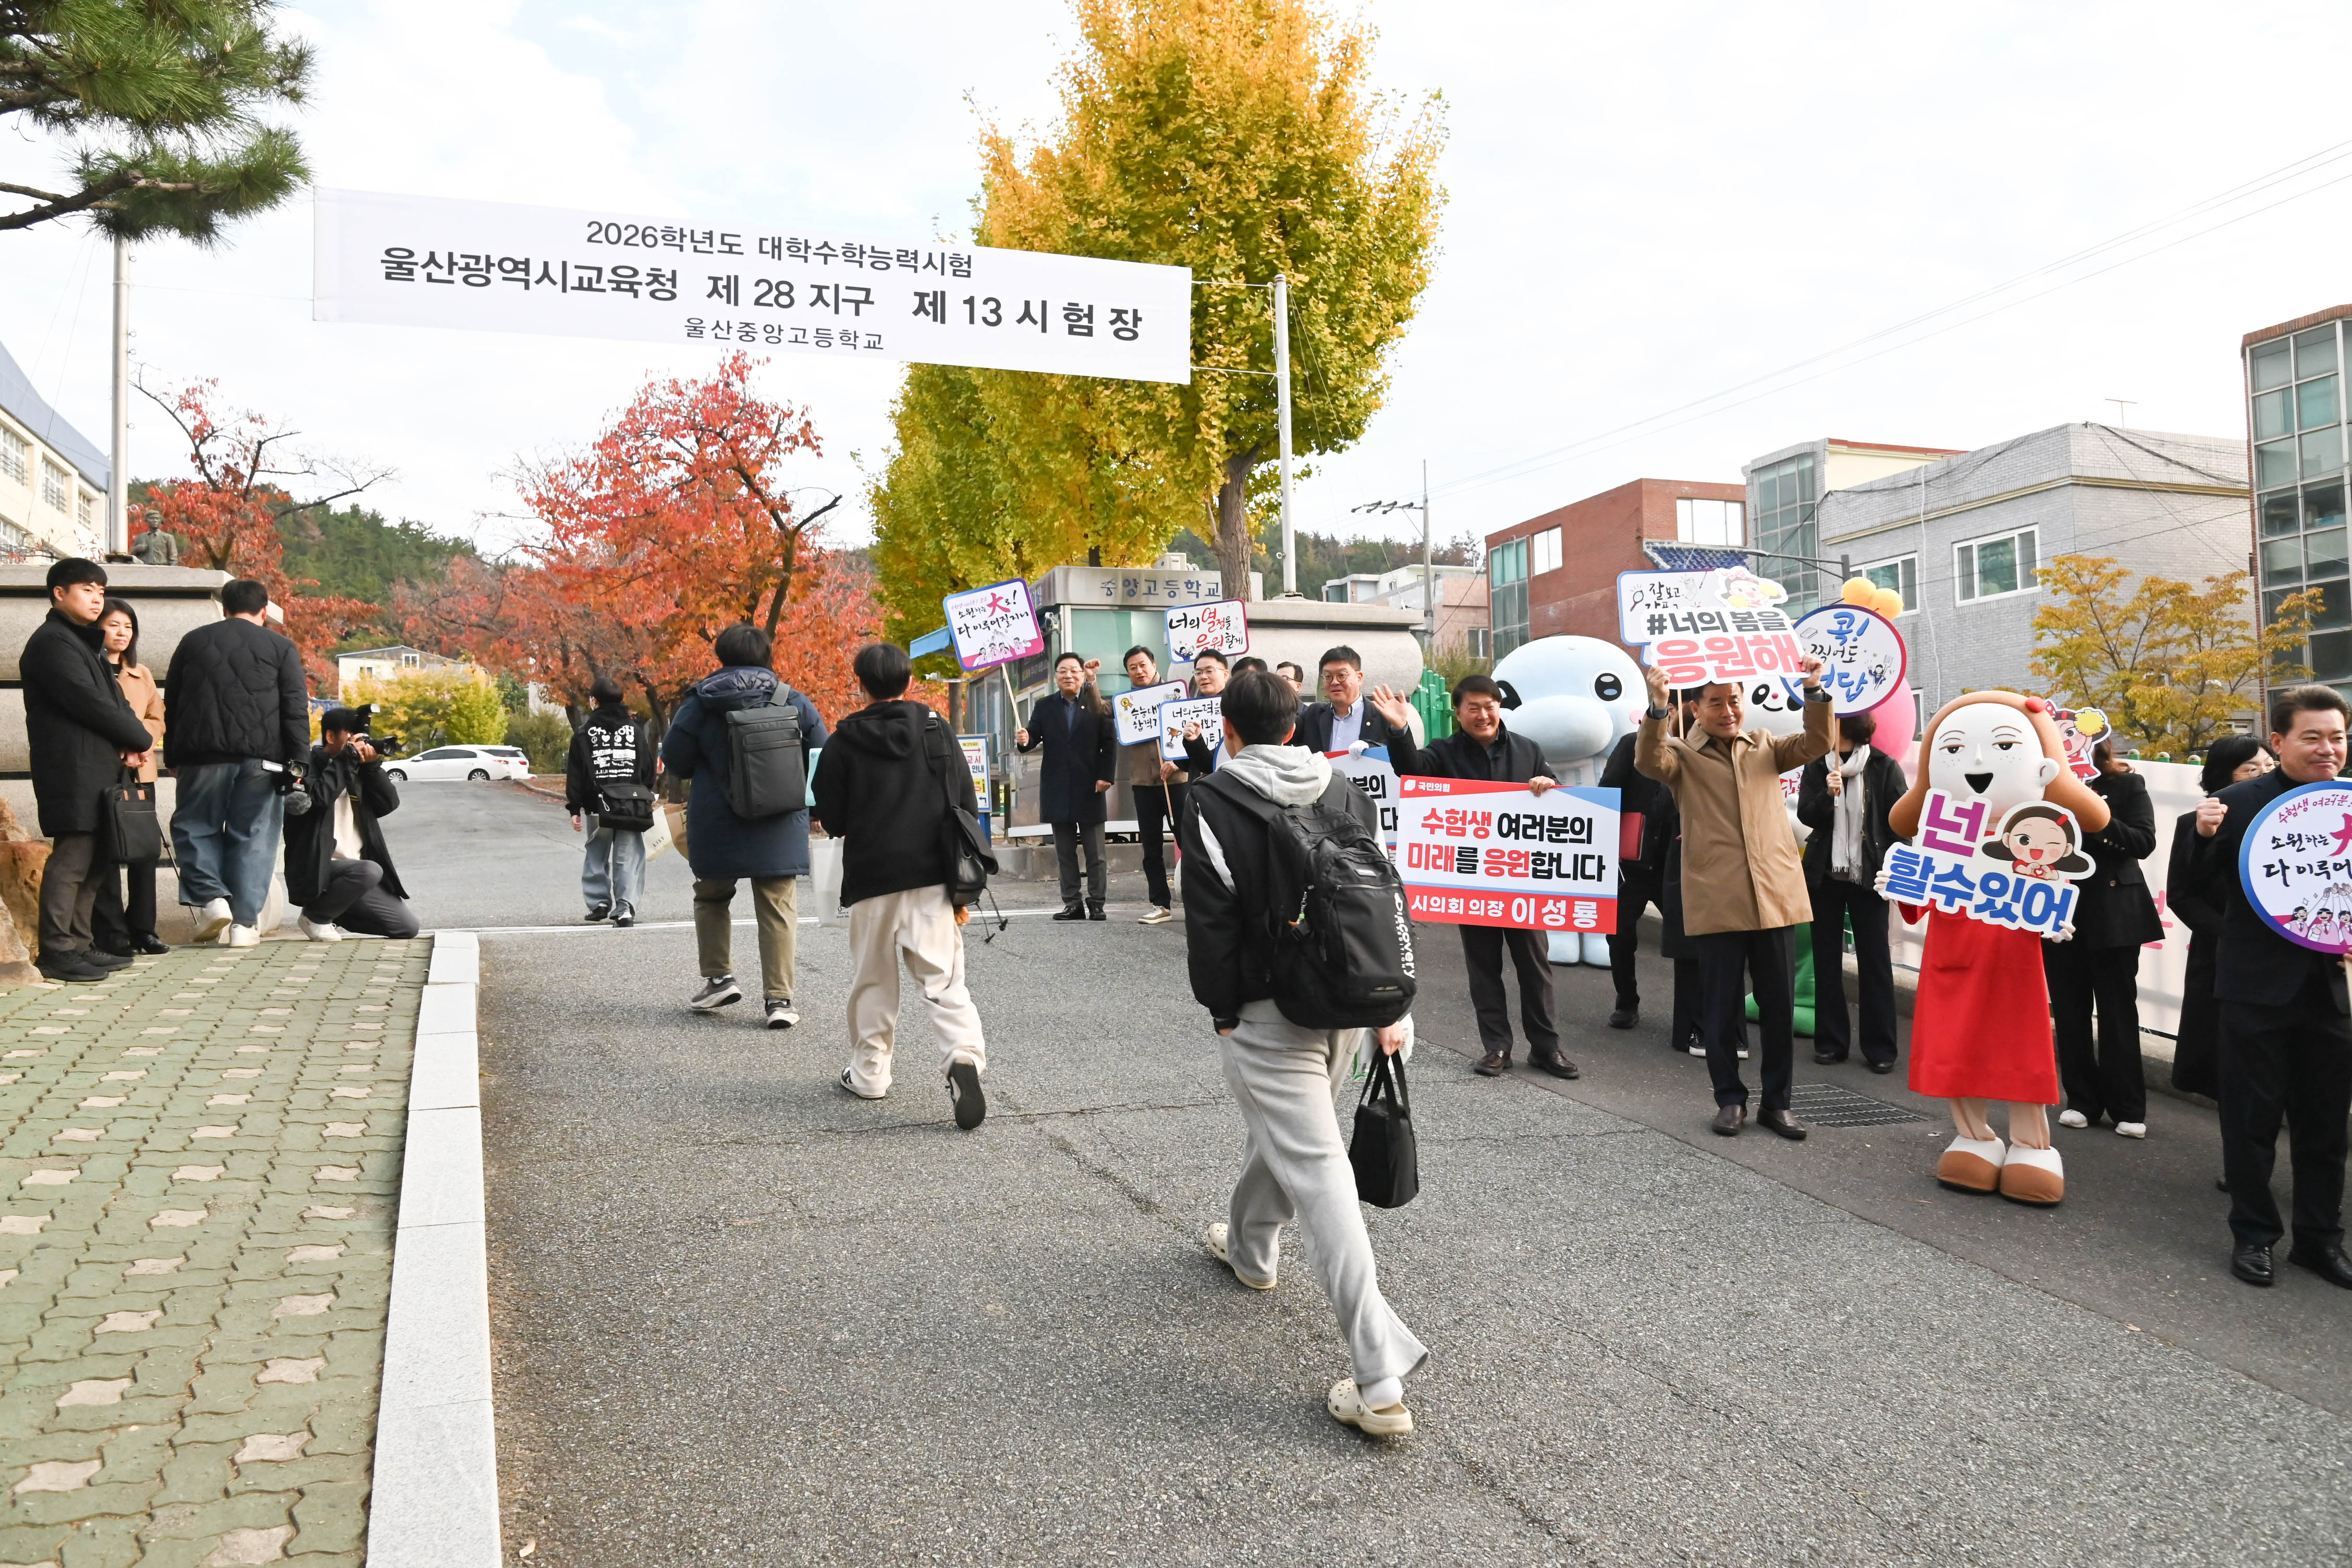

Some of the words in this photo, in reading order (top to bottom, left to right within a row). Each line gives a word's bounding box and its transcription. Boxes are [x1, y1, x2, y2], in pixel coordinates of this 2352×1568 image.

[586, 220, 744, 255] 2026학년도
[758, 236, 972, 278] 대학수학능력시험
[381, 246, 678, 302] 울산광역시교육청
[706, 274, 740, 307] 제
[753, 279, 795, 309] 28
[809, 283, 875, 316] 지구
[912, 289, 947, 325] 제
[962, 296, 1002, 327] 13
[684, 317, 884, 351] 울산중앙고등학교
[957, 623, 971, 638] 다
[973, 611, 1029, 631] 이루어질지니
[1169, 612, 1200, 630] 너의
[1202, 607, 1231, 633] 열정을
[1647, 611, 1729, 635] #너의
[1730, 611, 1787, 632] 봄을
[1827, 611, 1870, 646] 콕!
[1656, 634, 1807, 683] 응원해
[1810, 644, 1858, 664] 찍어도
[1131, 703, 1160, 719] 수능대
[1418, 781, 1450, 793] 국민의힘
[2279, 798, 2308, 823] 수험생
[1421, 807, 1491, 839] 수험생
[1498, 813, 1593, 844] 여러분의
[1922, 794, 1986, 858] 넌
[2271, 833, 2329, 852] 소원하는
[1407, 842, 1479, 874] 미래를
[1483, 849, 1606, 882] 응원합니다
[2262, 859, 2290, 887] 다
[1885, 848, 2073, 933] 할수있어
[1411, 895, 1464, 915] 시의회
[1468, 899, 1504, 917] 의장
